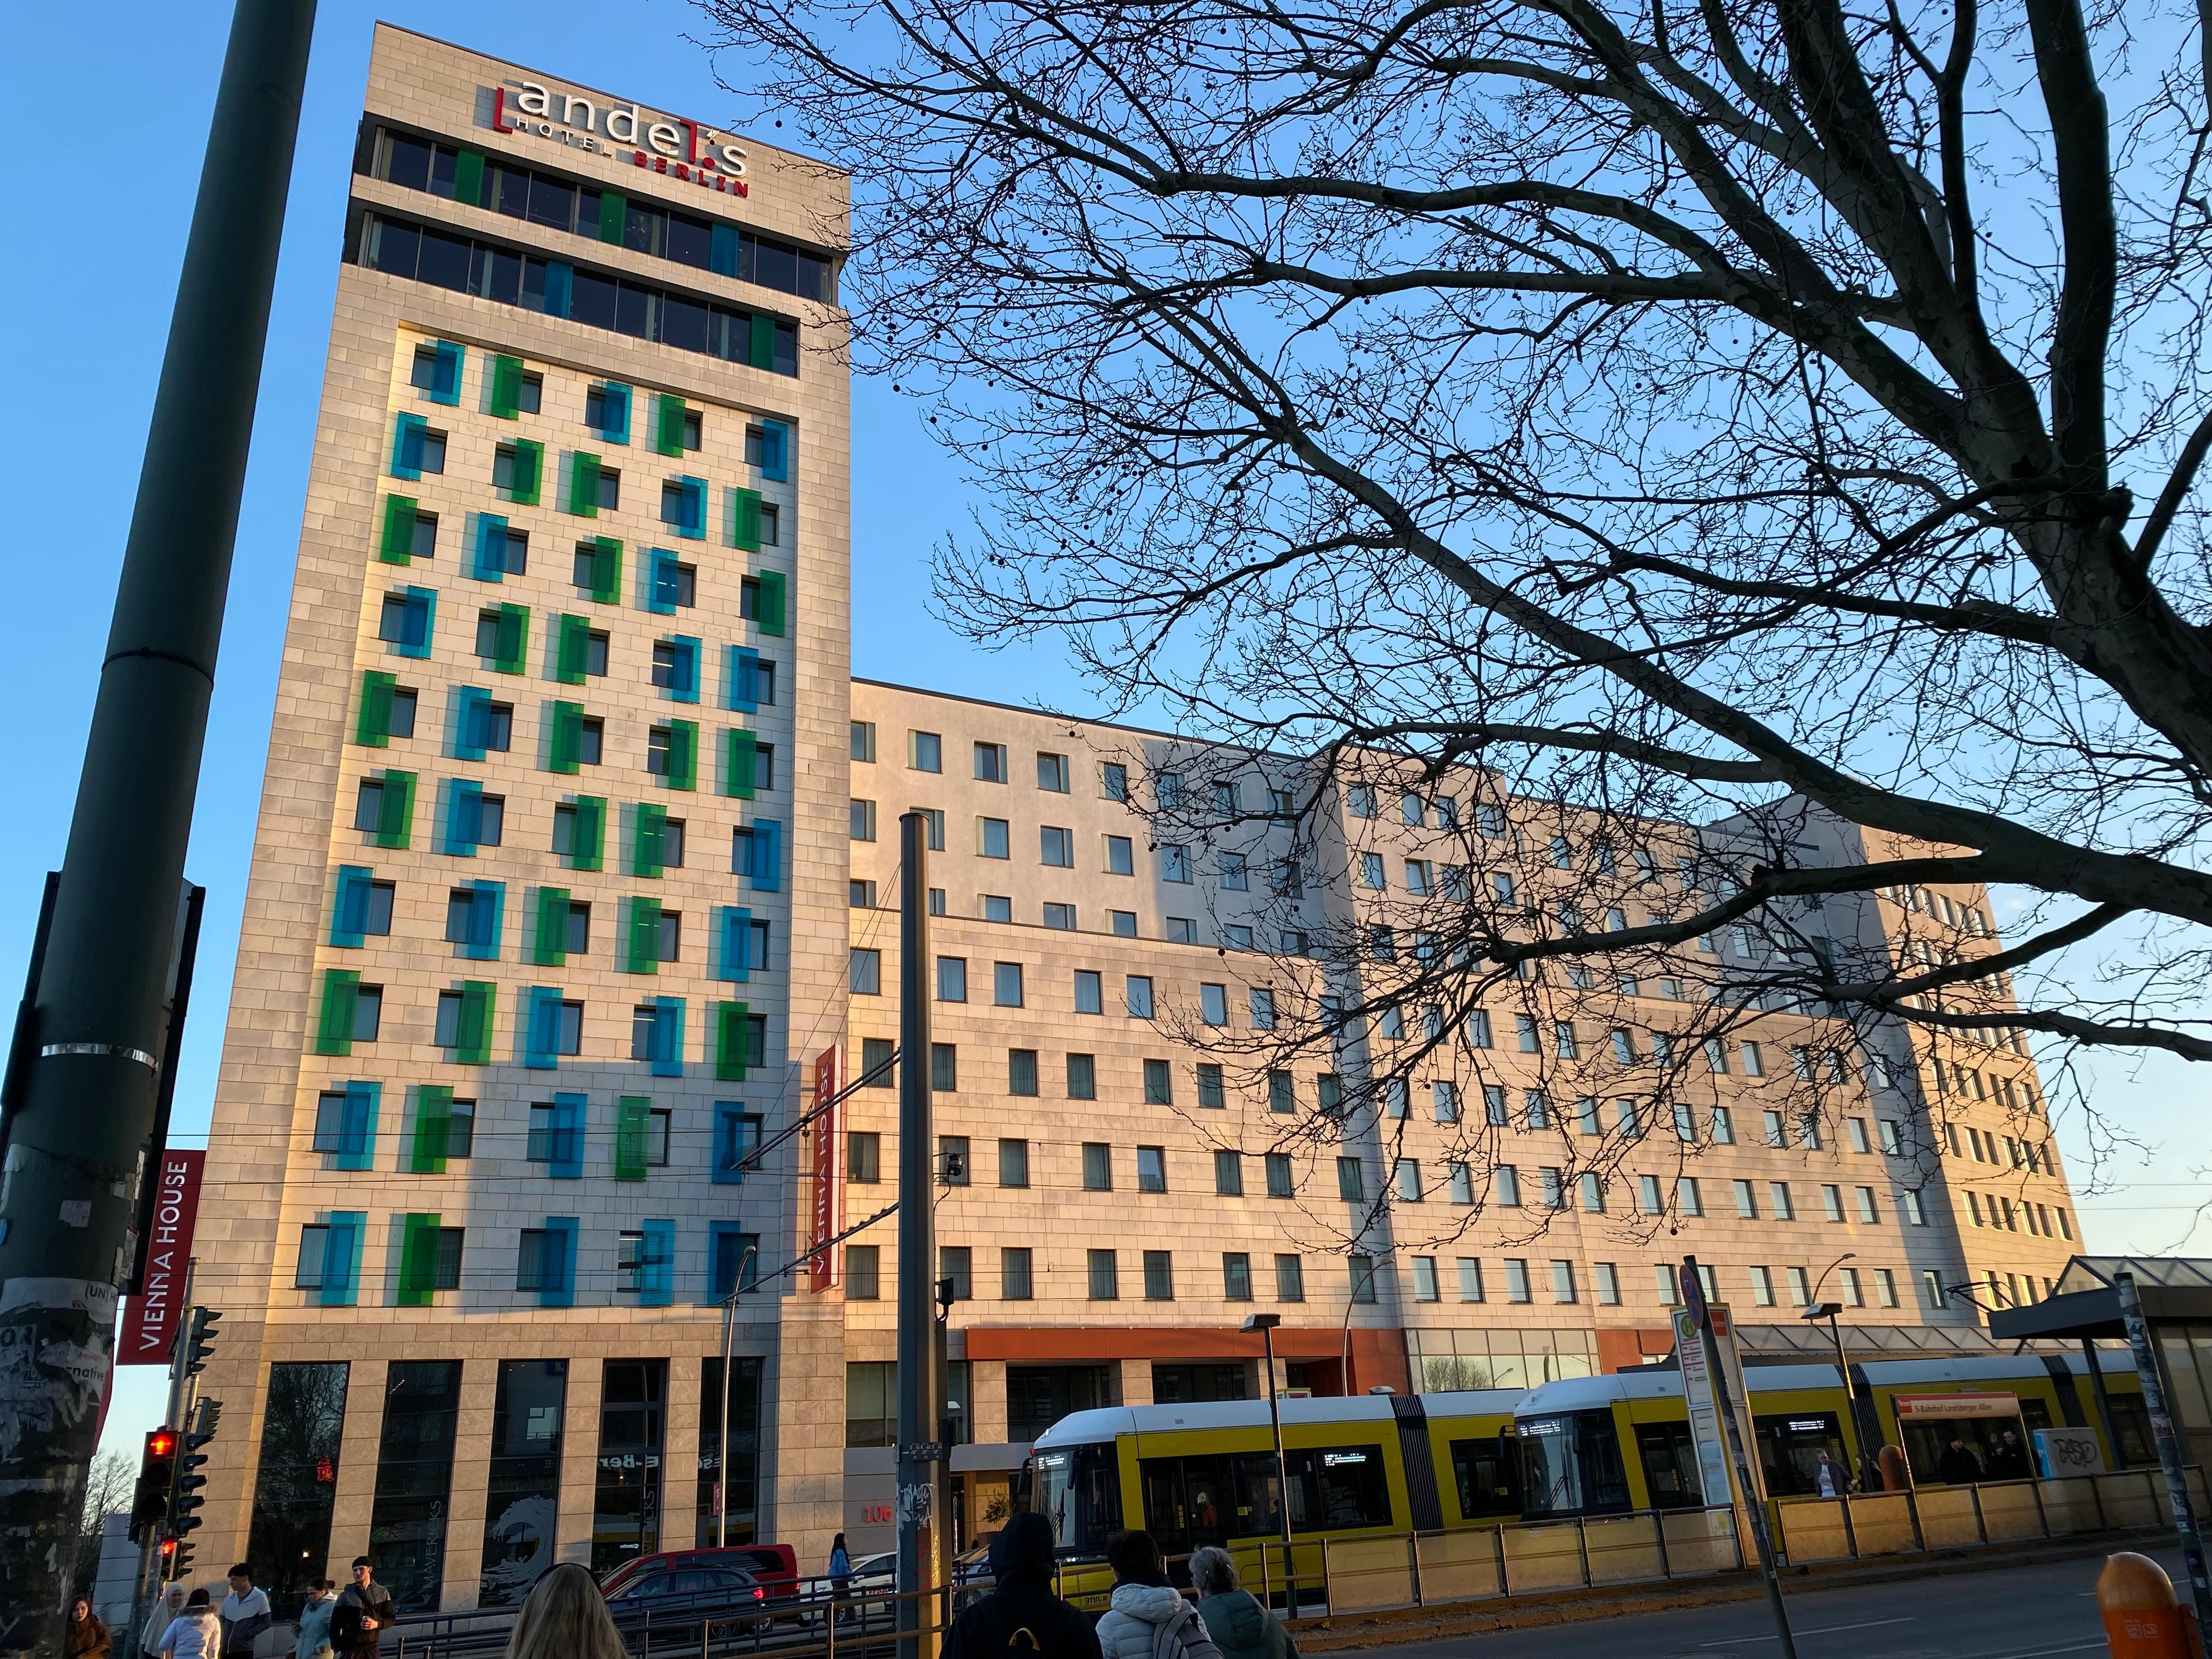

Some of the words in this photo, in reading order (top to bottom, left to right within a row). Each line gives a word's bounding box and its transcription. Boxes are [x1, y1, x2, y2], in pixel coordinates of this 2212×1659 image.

[516, 115, 612, 157] HOTEL
[634, 149, 748, 198] BERLIN
[156, 1161, 188, 1243] HOUSE
[817, 1163, 826, 1274] VENNA
[139, 1251, 174, 1351] VIENNA
[1915, 1404, 1944, 1413] S-Bahnhof
[1945, 1404, 1976, 1413] Landsberger
[422, 1500, 442, 1589] MAVERICKS
[865, 1505, 894, 1523] 106
